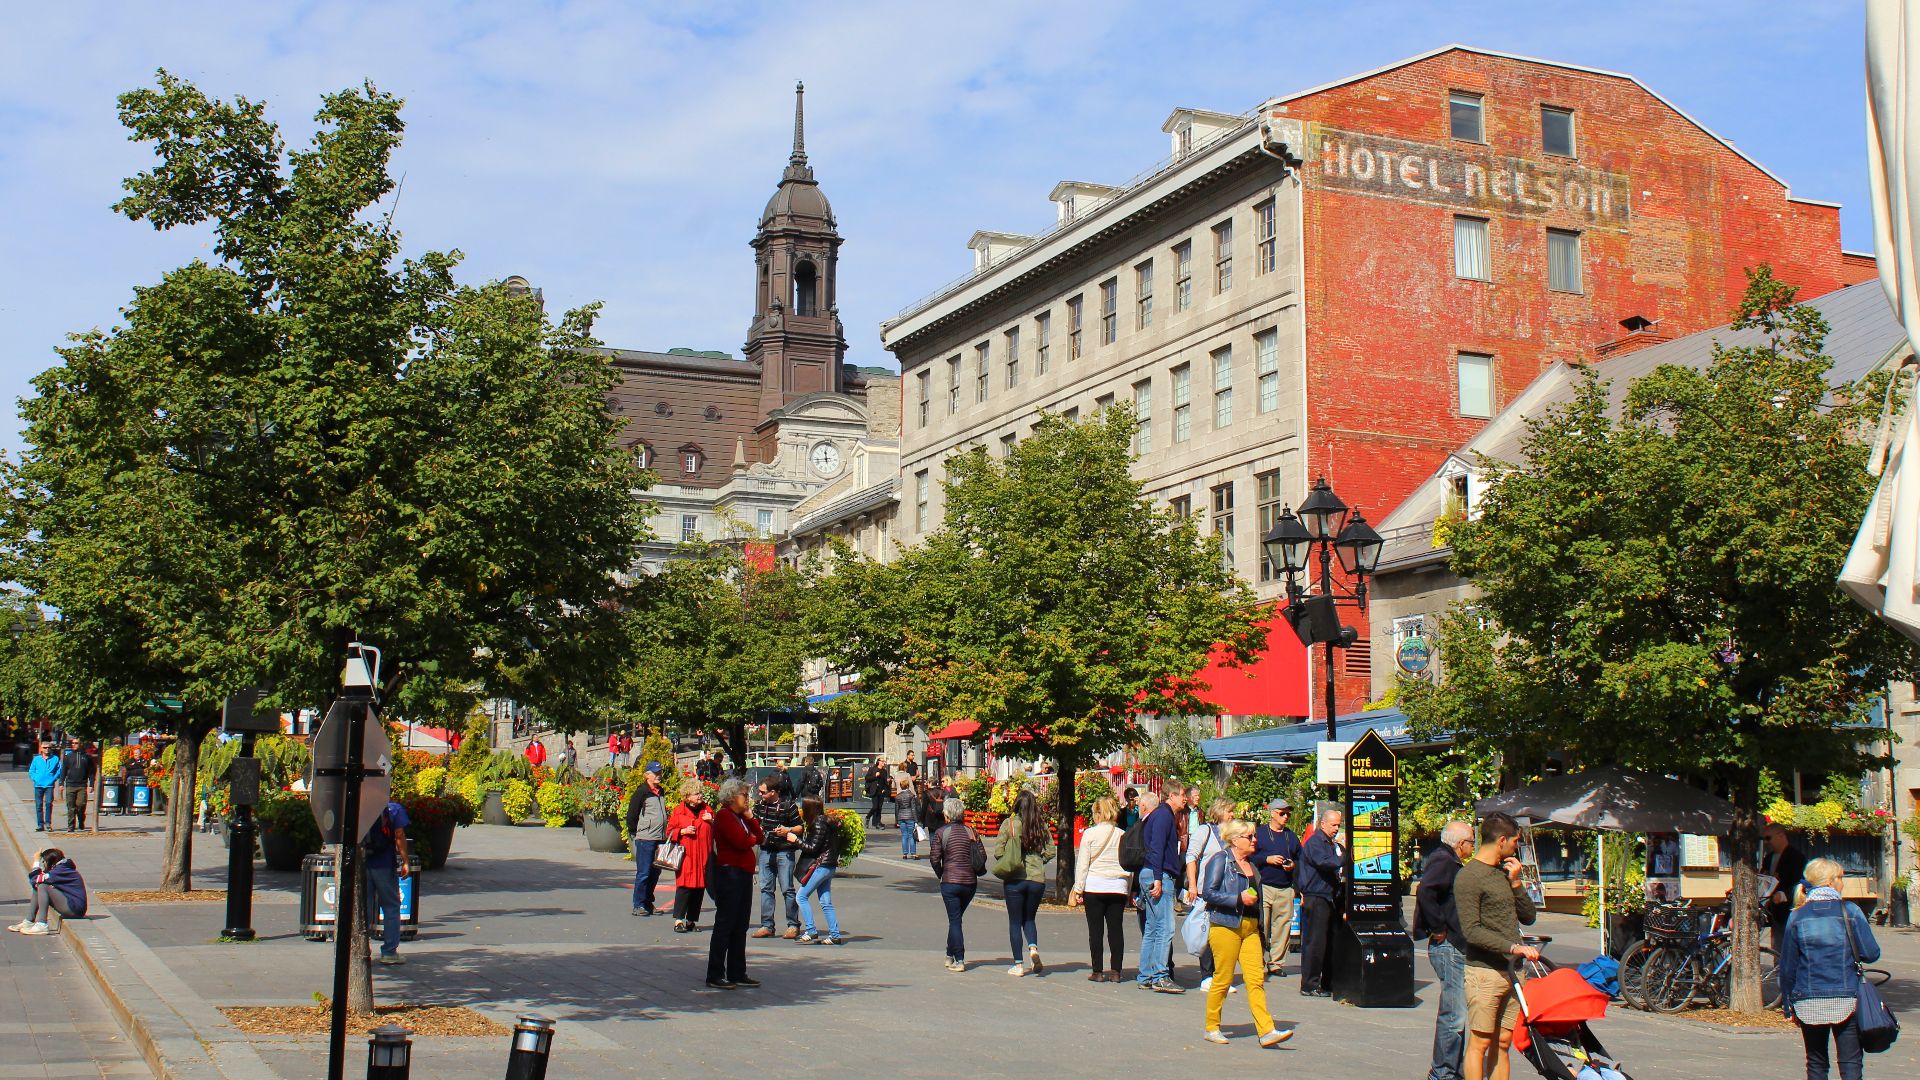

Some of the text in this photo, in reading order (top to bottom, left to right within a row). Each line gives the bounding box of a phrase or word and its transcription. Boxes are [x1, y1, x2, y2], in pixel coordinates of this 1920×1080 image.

[1322, 140, 1451, 194] HOTEL
[1352, 757, 1371, 767] CITÉ
[1352, 767, 1393, 778] MÉMOIRE
